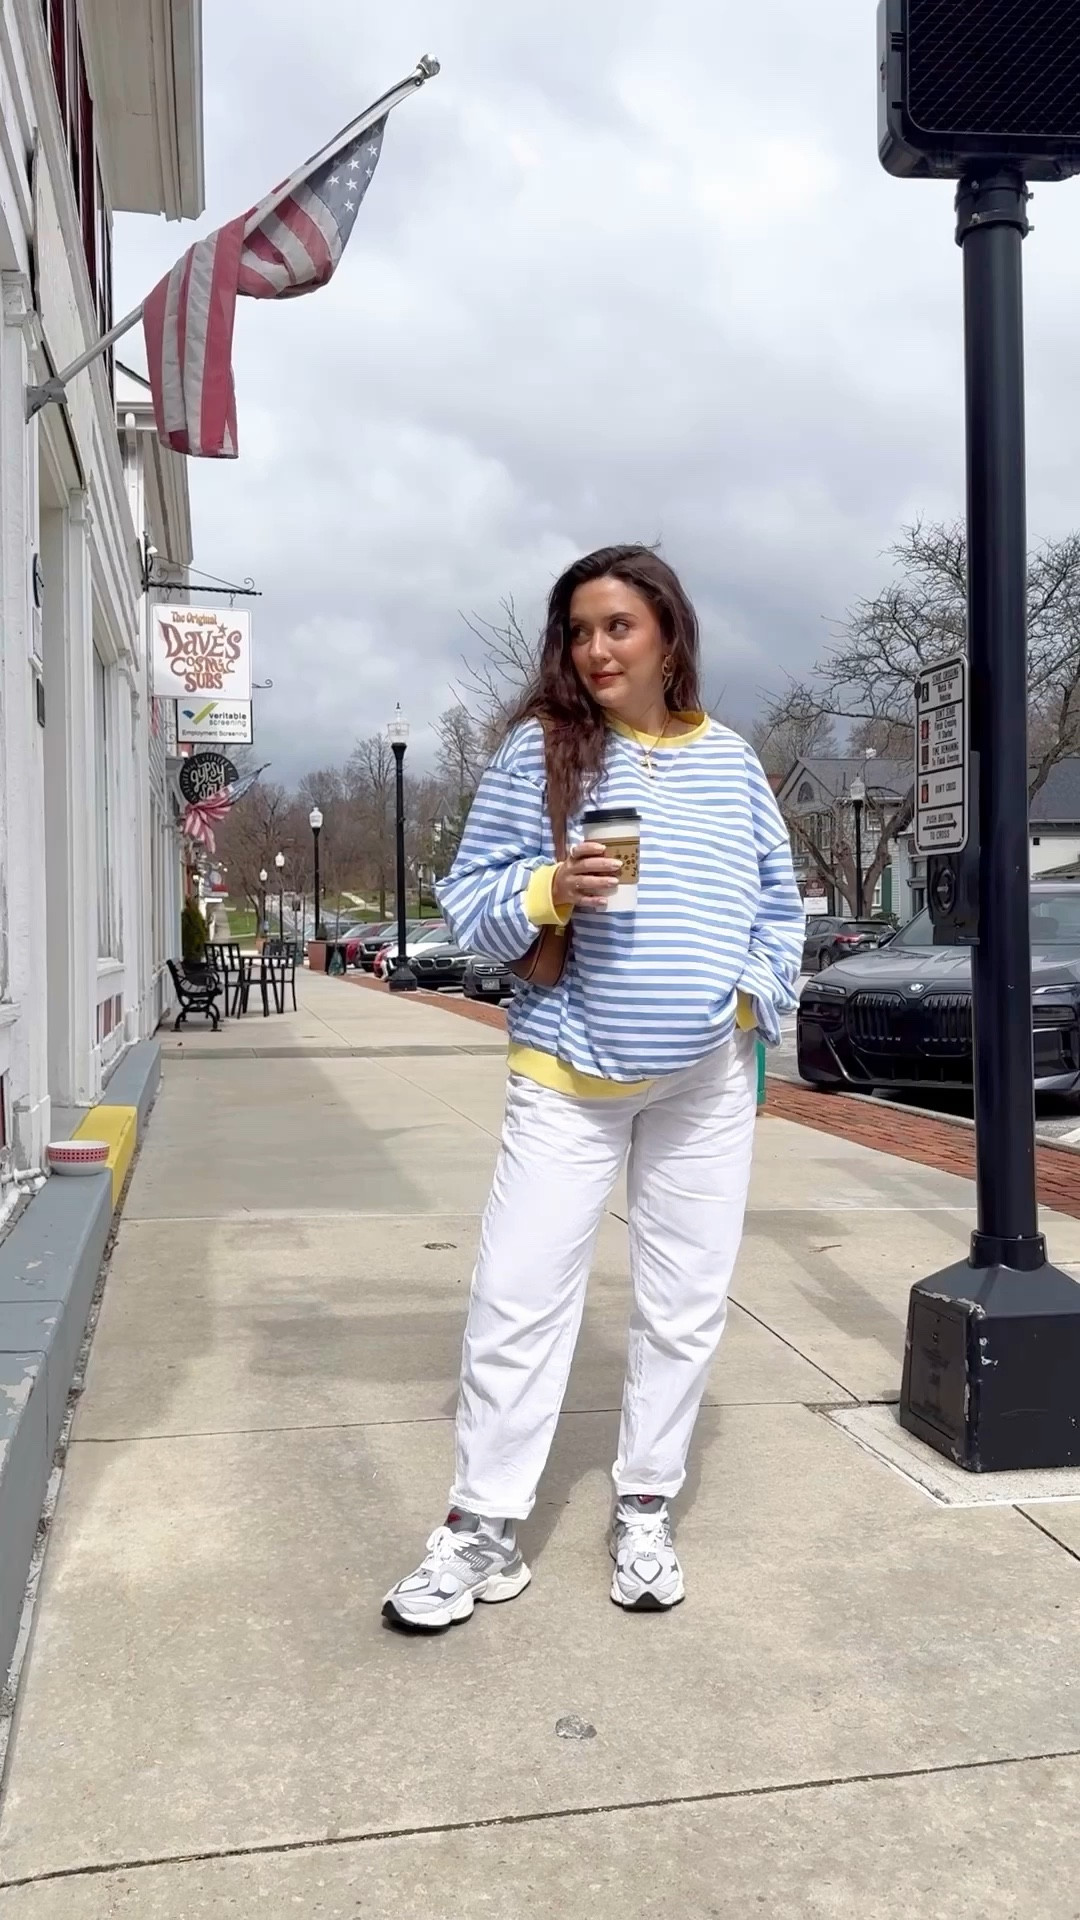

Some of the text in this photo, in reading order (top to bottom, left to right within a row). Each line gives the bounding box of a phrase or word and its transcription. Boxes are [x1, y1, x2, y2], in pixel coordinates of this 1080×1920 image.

[171, 611, 218, 626] The Original
[184, 671, 223, 693] SUBS
[208, 712, 247, 720] veritable
[209, 719, 247, 727] screening
[219, 730, 247, 738] Screening
[926, 812, 953, 824] PUSH BUTTON
[929, 829, 950, 840] TO CROSS
